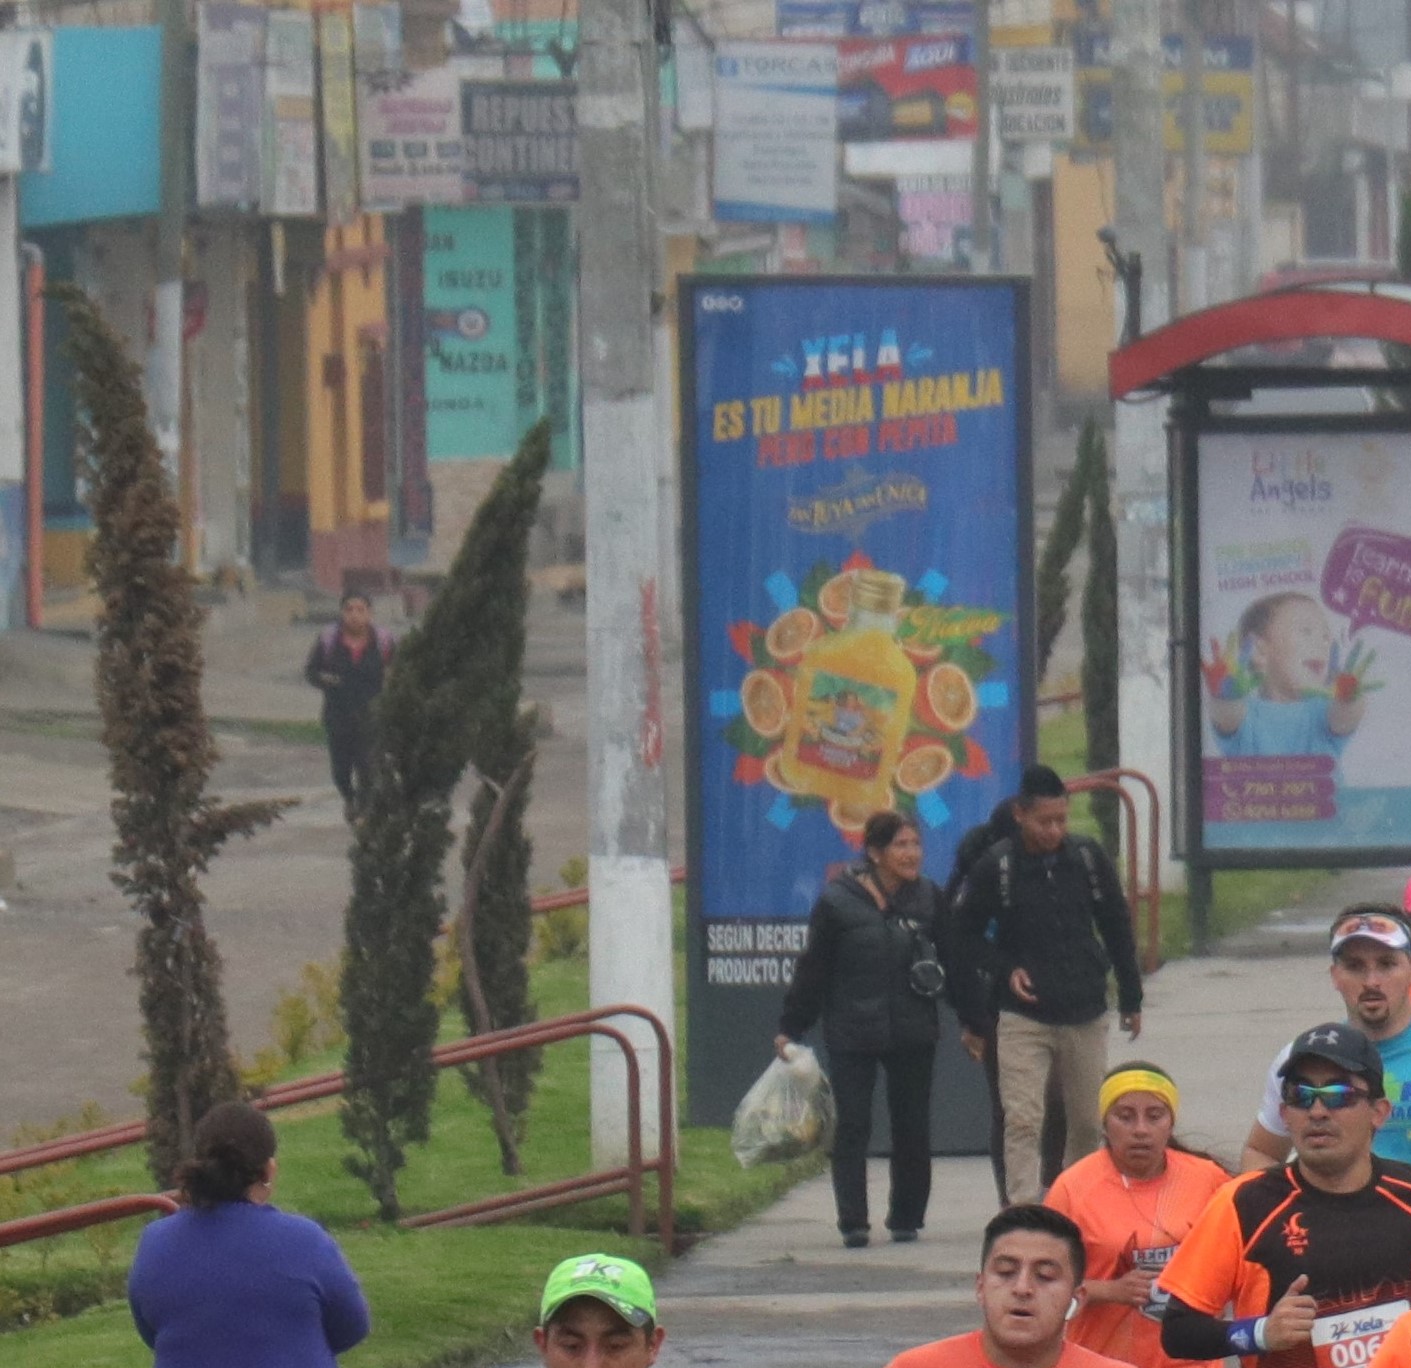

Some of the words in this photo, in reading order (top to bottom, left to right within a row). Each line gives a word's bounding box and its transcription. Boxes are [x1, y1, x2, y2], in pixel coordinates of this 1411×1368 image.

[802, 328, 903, 391] XELA
[713, 400, 745, 443] ES
[750, 394, 783, 437] TU
[789, 385, 874, 432] MEDIA
[881, 367, 1004, 419] NARANJA
[1250, 474, 1333, 506] Angels
[707, 957, 778, 985] PRODUCTO
